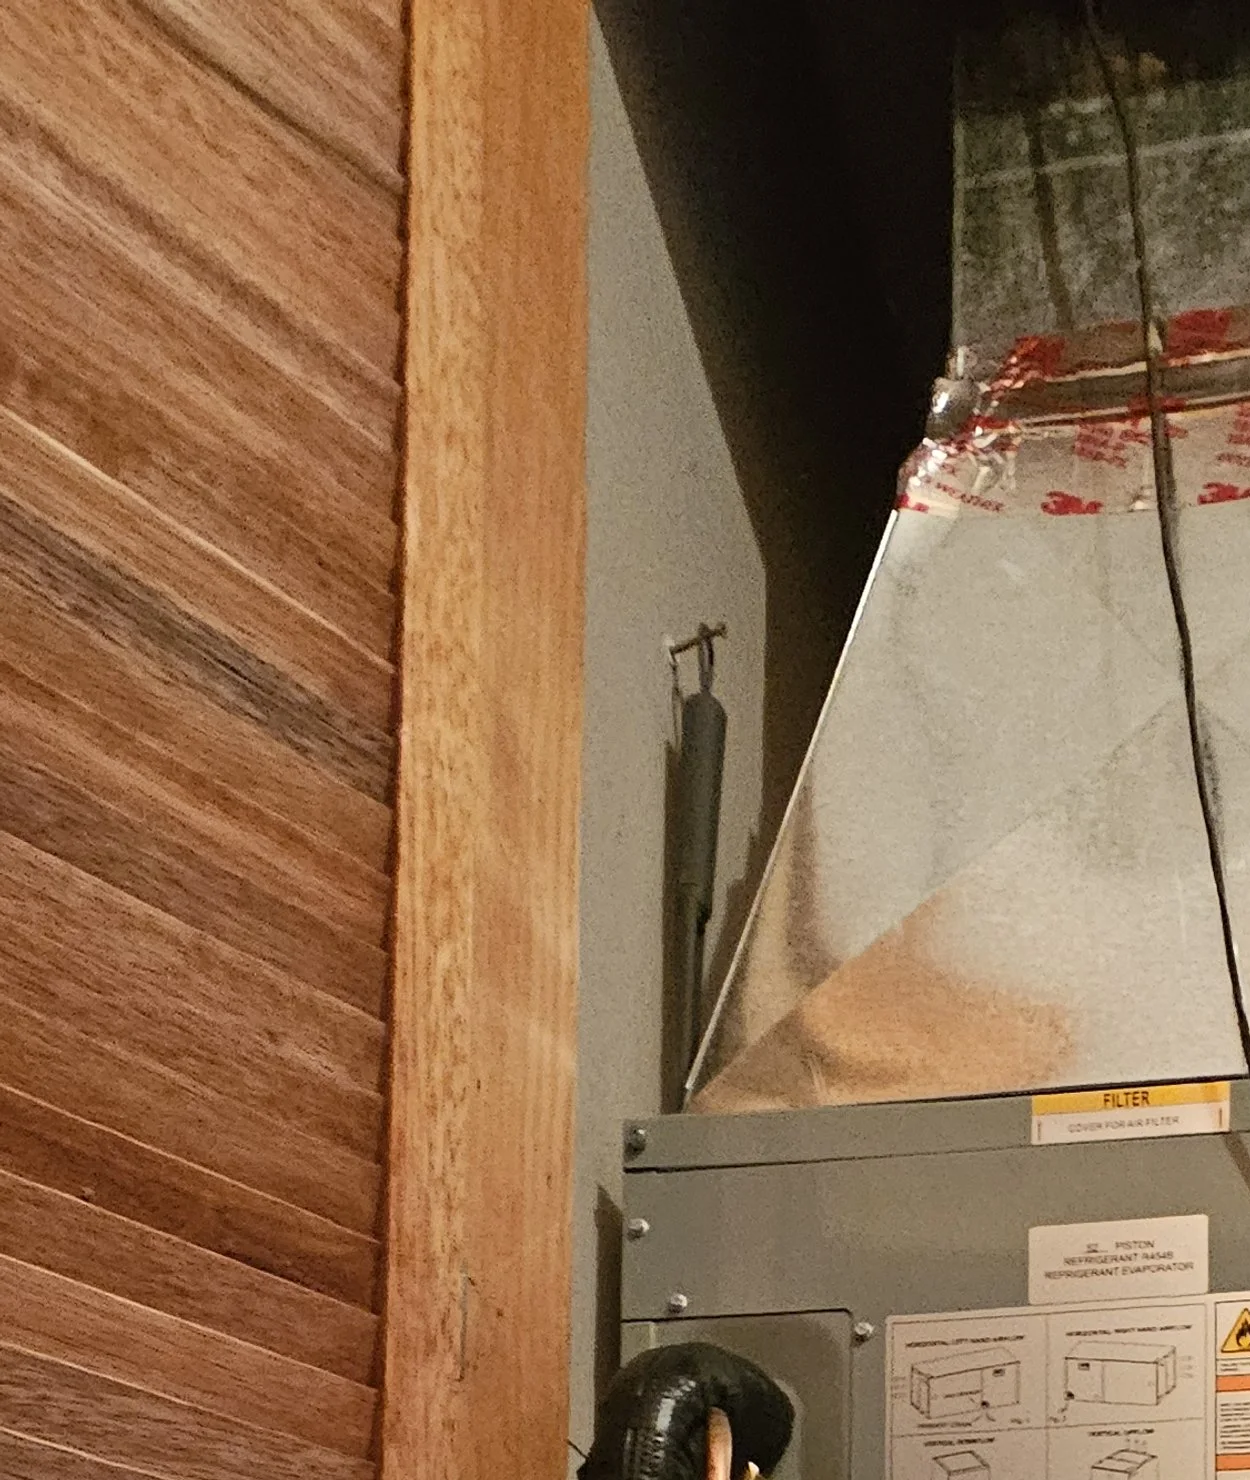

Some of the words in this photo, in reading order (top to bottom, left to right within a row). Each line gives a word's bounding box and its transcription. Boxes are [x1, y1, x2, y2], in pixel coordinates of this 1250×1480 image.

[1103, 1091, 1150, 1108] FILTER
[1068, 1122, 1102, 1133] COVER
[1105, 1120, 1125, 1131] FOR
[1126, 1119, 1144, 1129] AIR
[1145, 1116, 1181, 1127] FILTER
[1115, 1240, 1155, 1250] PISTON
[1064, 1253, 1138, 1266] REFRIGERANT
[1044, 1266, 1119, 1279] REFRIGERANT
[1121, 1261, 1195, 1276] EVAPORATOR
